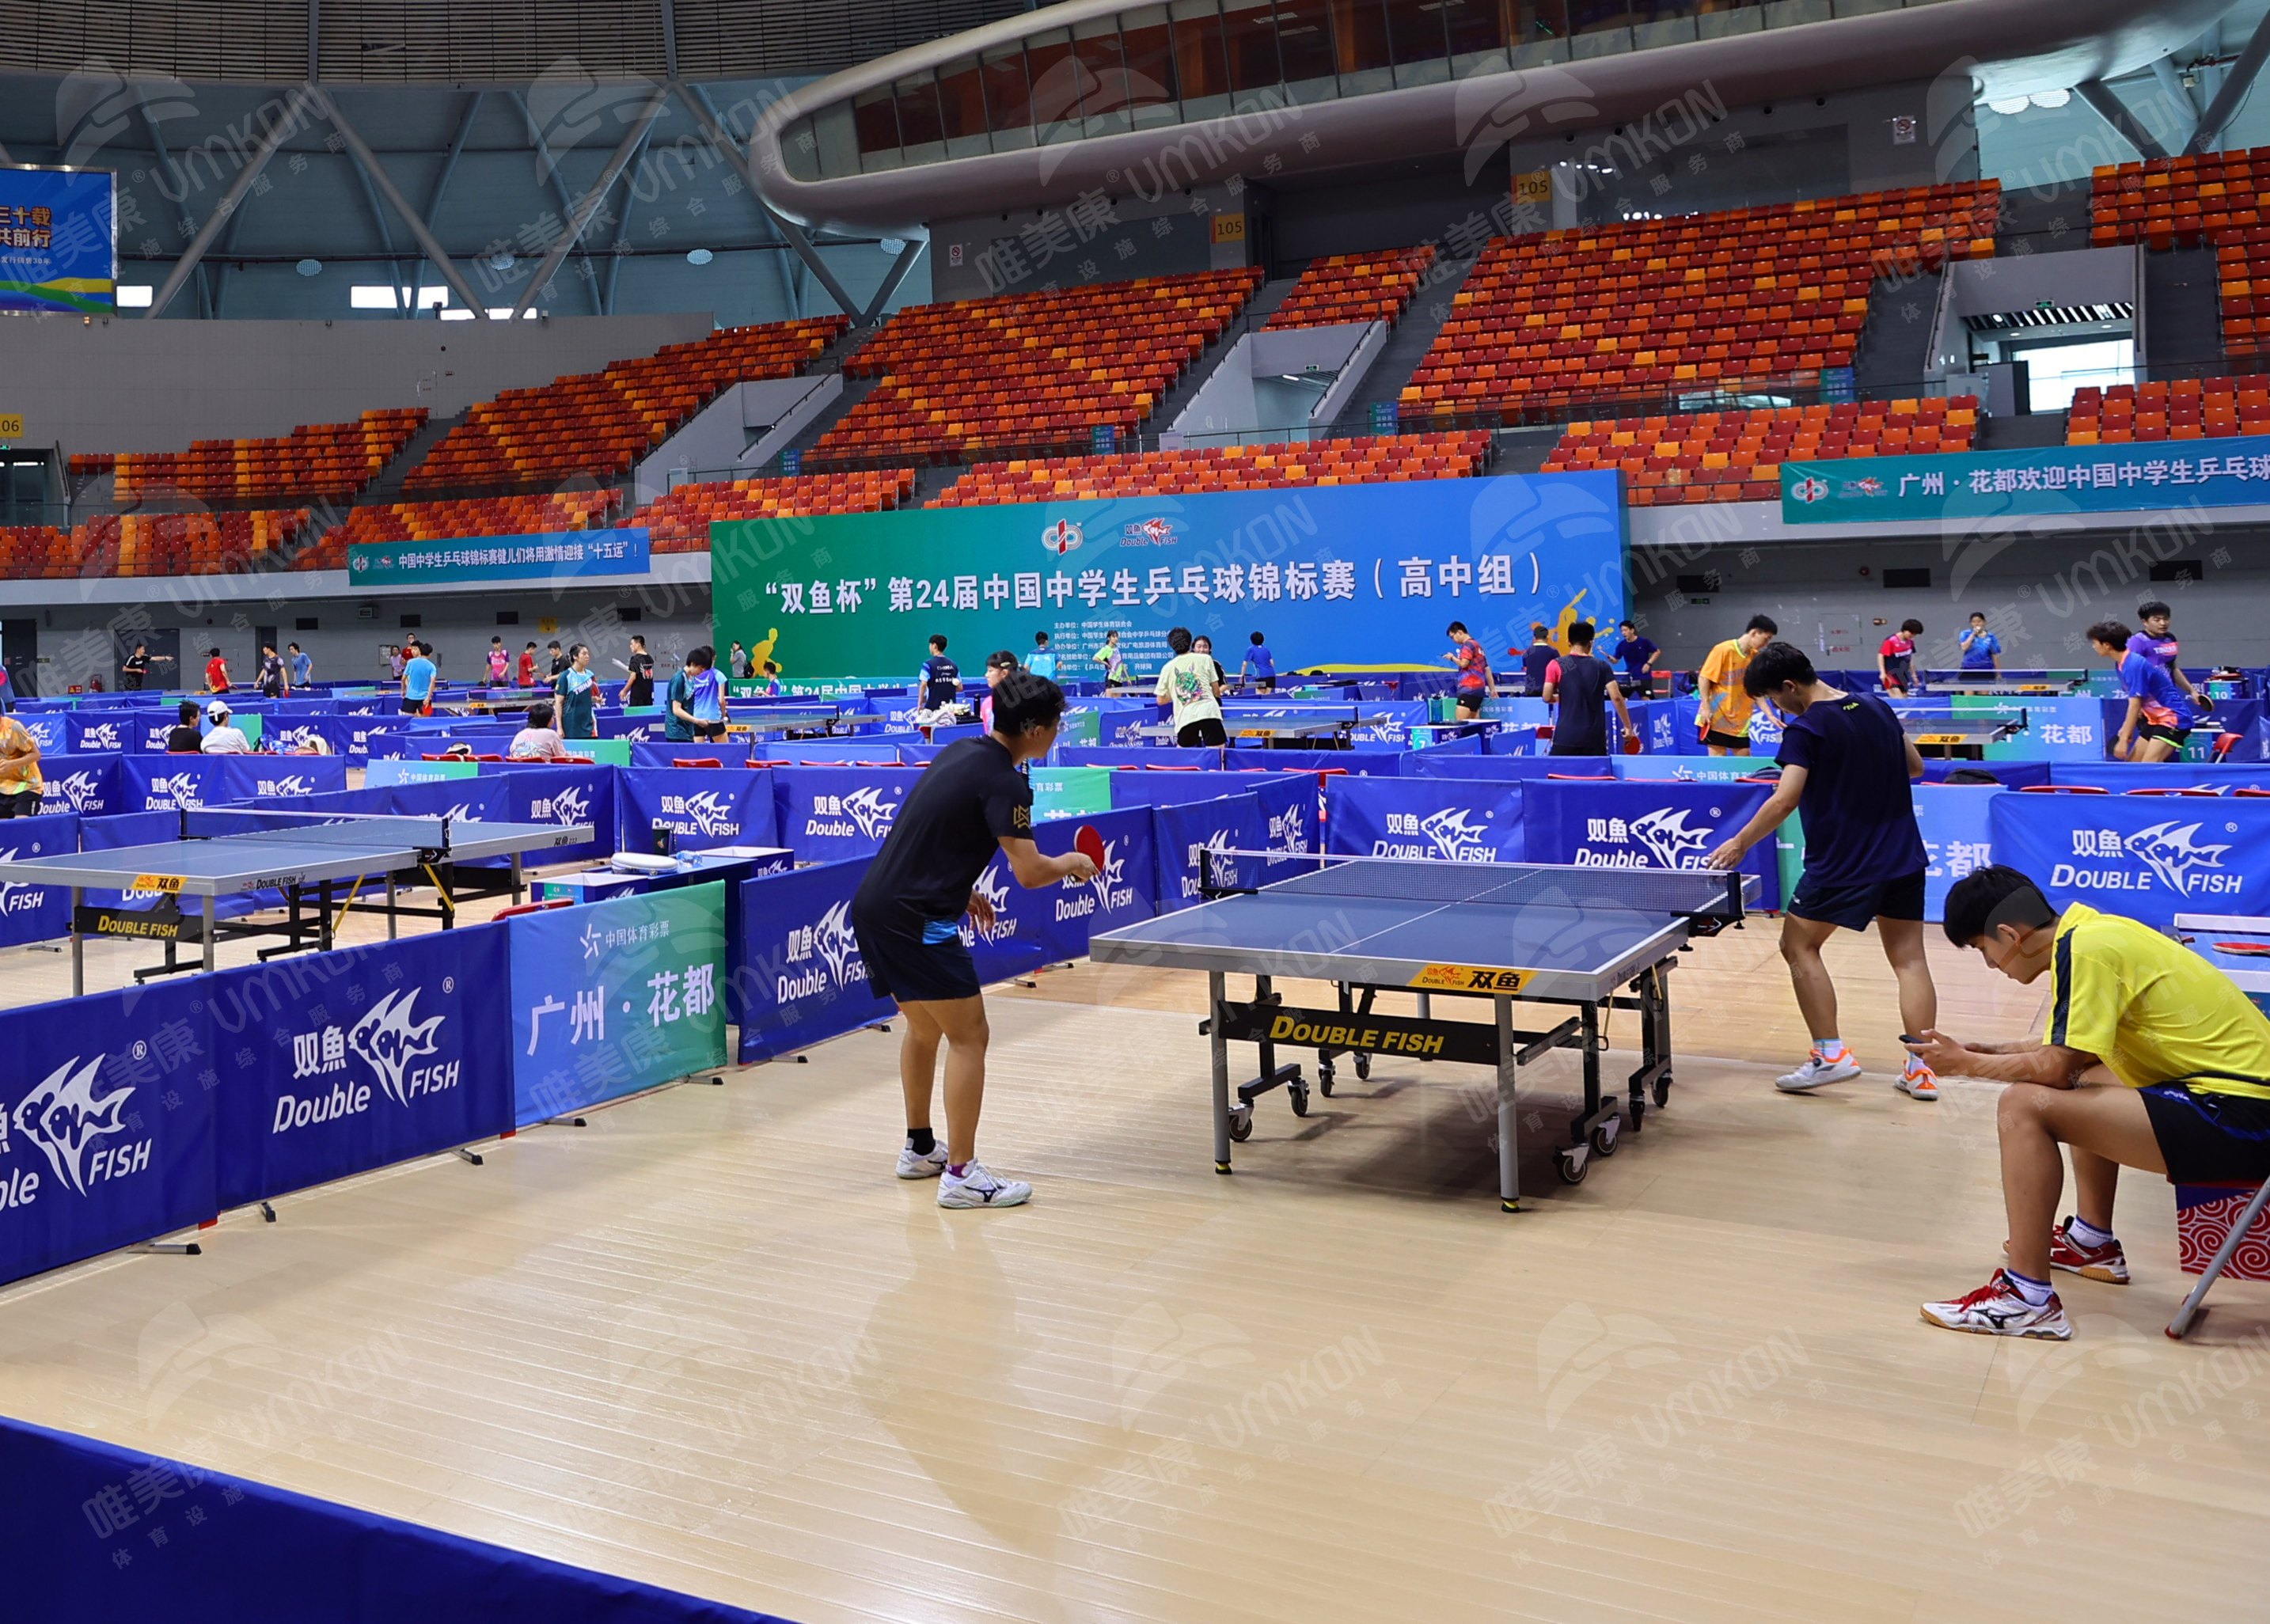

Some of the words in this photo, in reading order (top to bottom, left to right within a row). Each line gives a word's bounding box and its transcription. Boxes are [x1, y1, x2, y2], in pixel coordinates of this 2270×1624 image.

[1518, 180, 1548, 196] 105
[1217, 221, 1242, 236] 105
[0, 420, 19, 432] 06
[80, 739, 101, 749] Double
[108, 741, 122, 749] FISH
[146, 739, 165, 749] Double
[2188, 746, 2206, 758] 11
[83, 799, 104, 810] FISH
[712, 823, 739, 836] FISH
[806, 819, 855, 837] Double
[875, 825, 892, 837] FI
[1459, 847, 1497, 863] FISH
[1575, 848, 1648, 869] Double
[1682, 855, 1710, 870] FIS
[158, 878, 180, 891] 双鱼
[283, 875, 297, 886] FISH
[2187, 874, 2243, 894] FISH
[9, 892, 44, 912] FISH
[1056, 894, 1095, 922] Double
[1111, 887, 1133, 909] FISH
[152, 919, 178, 938] FISH
[605, 920, 670, 949] 中国体育彩票
[992, 918, 1018, 940] FISH
[777, 967, 827, 1004] Double
[1468, 970, 1521, 992] 双鱼
[1270, 1015, 1378, 1049] DOUBLE
[1382, 1030, 1444, 1054] FISH
[272, 1080, 371, 1134] Double
[409, 1059, 461, 1099] FISH
[89, 1138, 152, 1186] FISH
